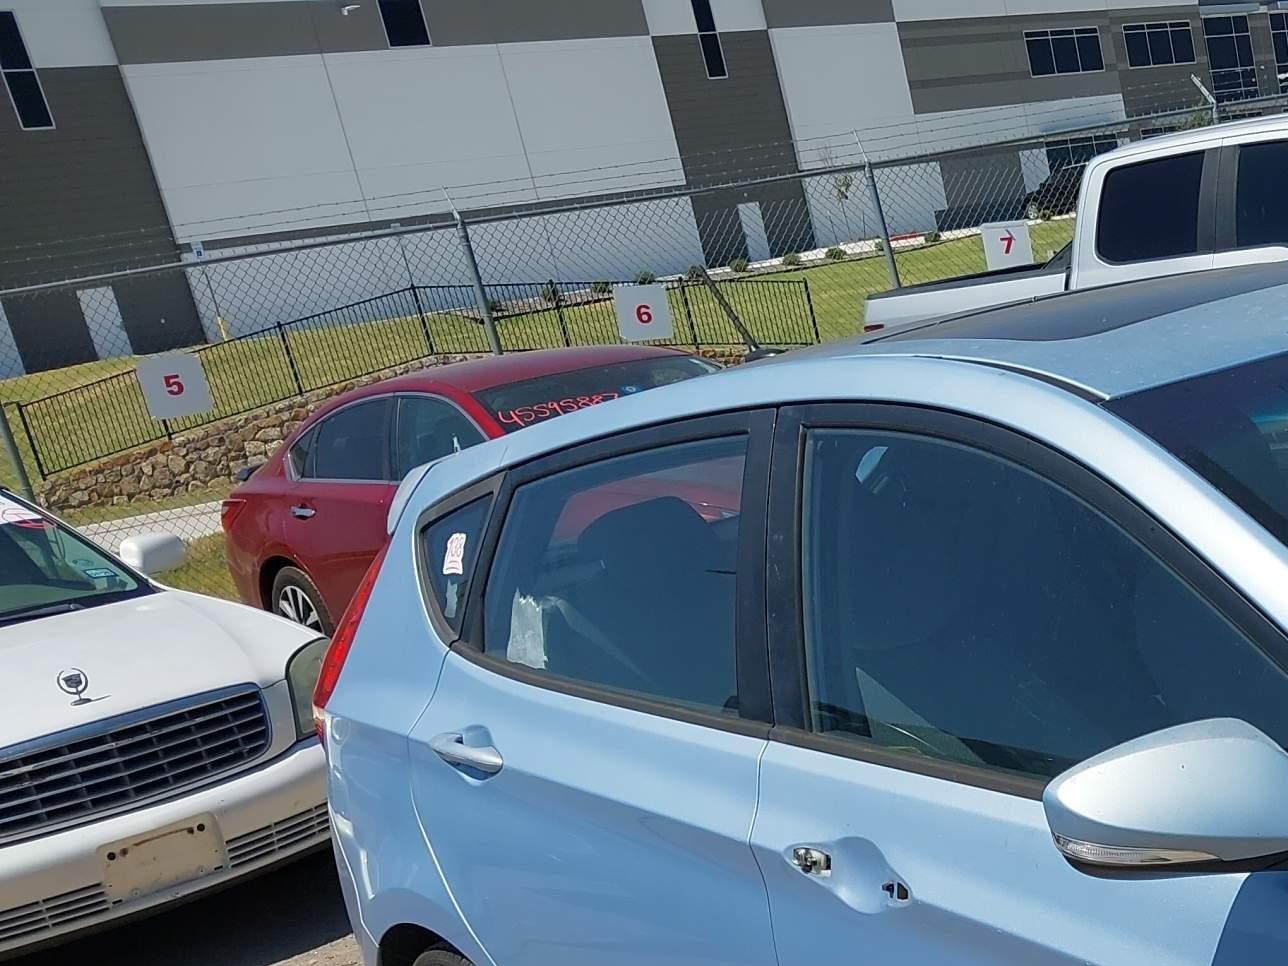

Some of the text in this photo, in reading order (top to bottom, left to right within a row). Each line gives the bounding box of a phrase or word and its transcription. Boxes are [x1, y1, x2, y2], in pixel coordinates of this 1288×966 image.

[999, 236, 1014, 255] 7
[636, 304, 653, 324] 6
[163, 374, 185, 396] 5
